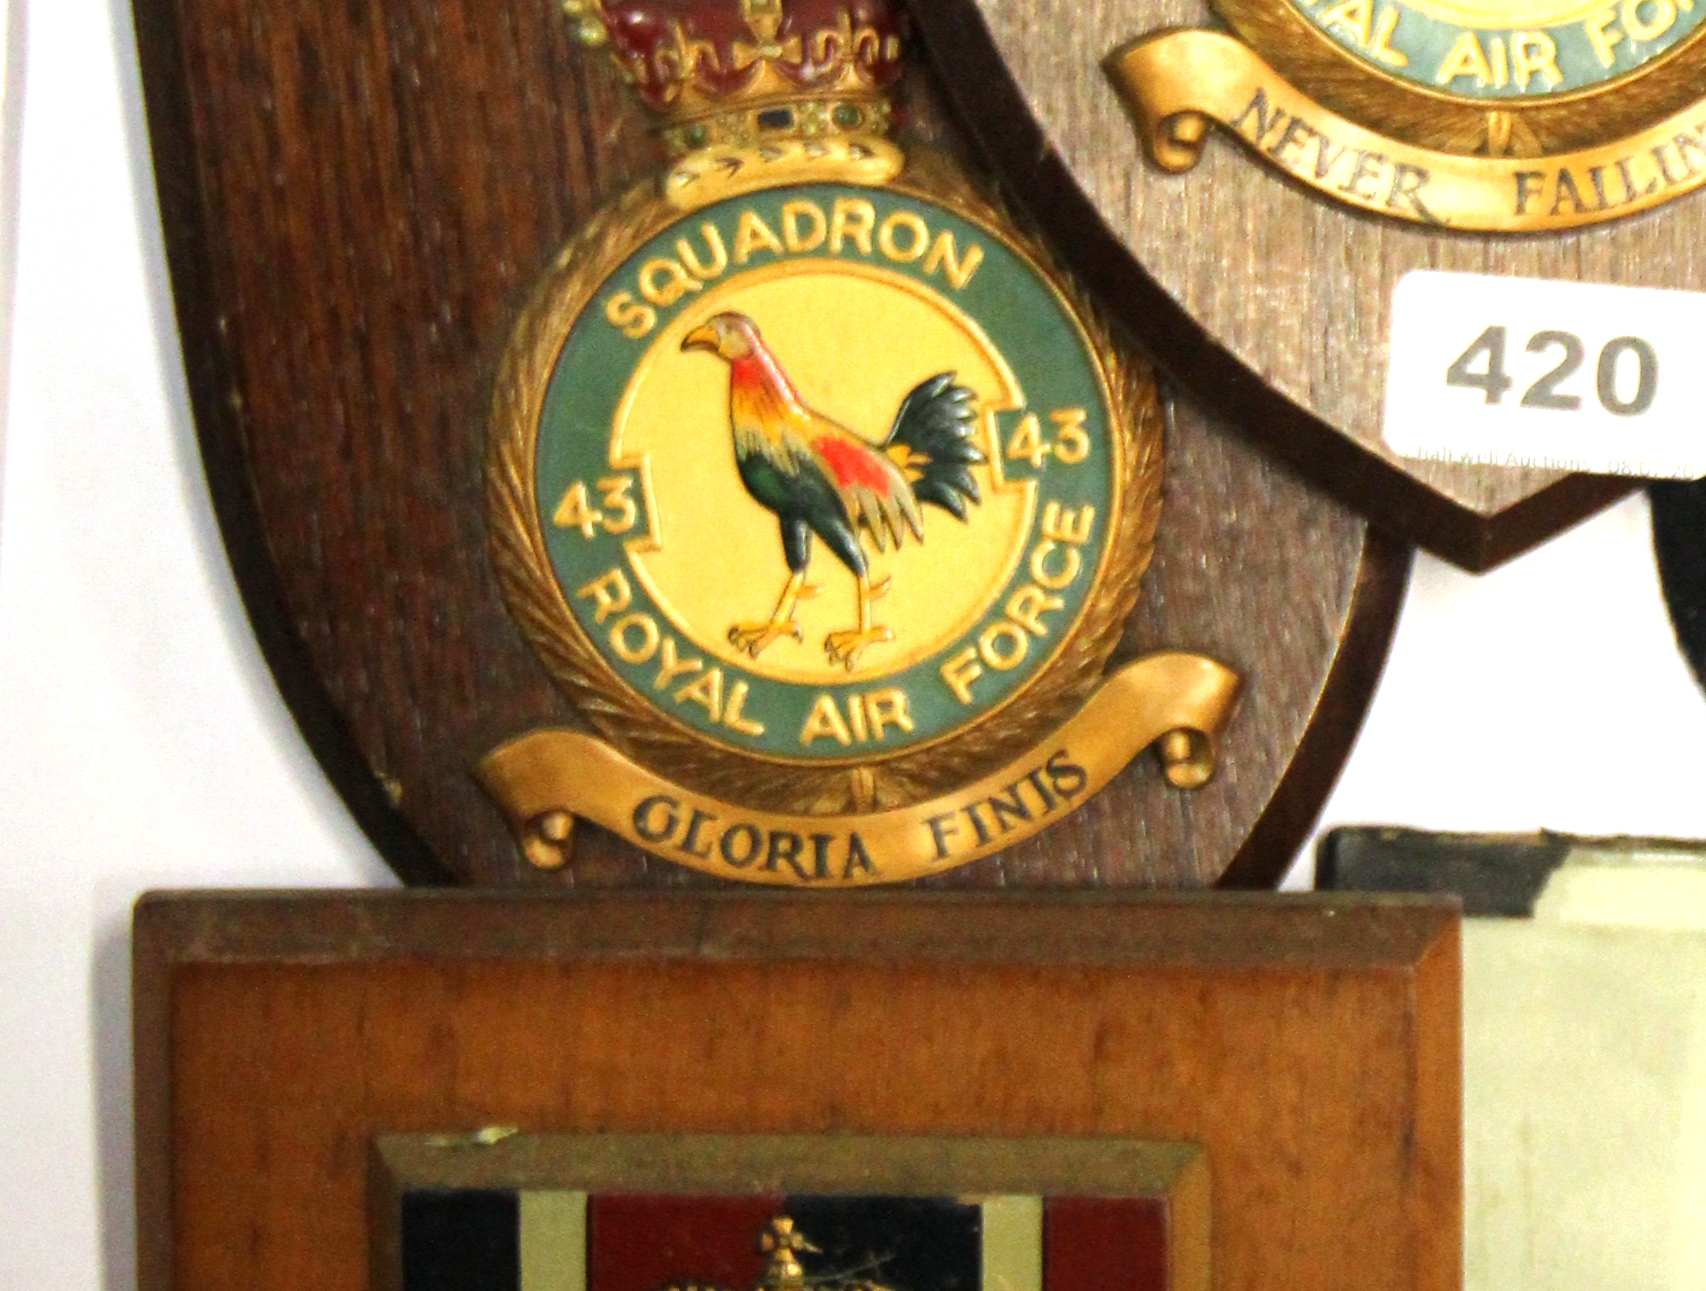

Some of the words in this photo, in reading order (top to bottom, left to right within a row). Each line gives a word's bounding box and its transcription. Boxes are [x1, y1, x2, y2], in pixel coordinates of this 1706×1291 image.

[1436, 30, 1564, 89] AIR
[1234, 86, 1450, 224] NEVER
[606, 197, 984, 340] SQUADRON
[1446, 325, 1659, 417] 420
[1005, 408, 1088, 470] 43
[553, 477, 638, 541] 43
[577, 567, 764, 738] ROYAL
[800, 686, 914, 747] AIR
[940, 500, 1095, 705] FORCE
[631, 792, 883, 880] GLORIA
[925, 748, 1089, 861] FINIS
